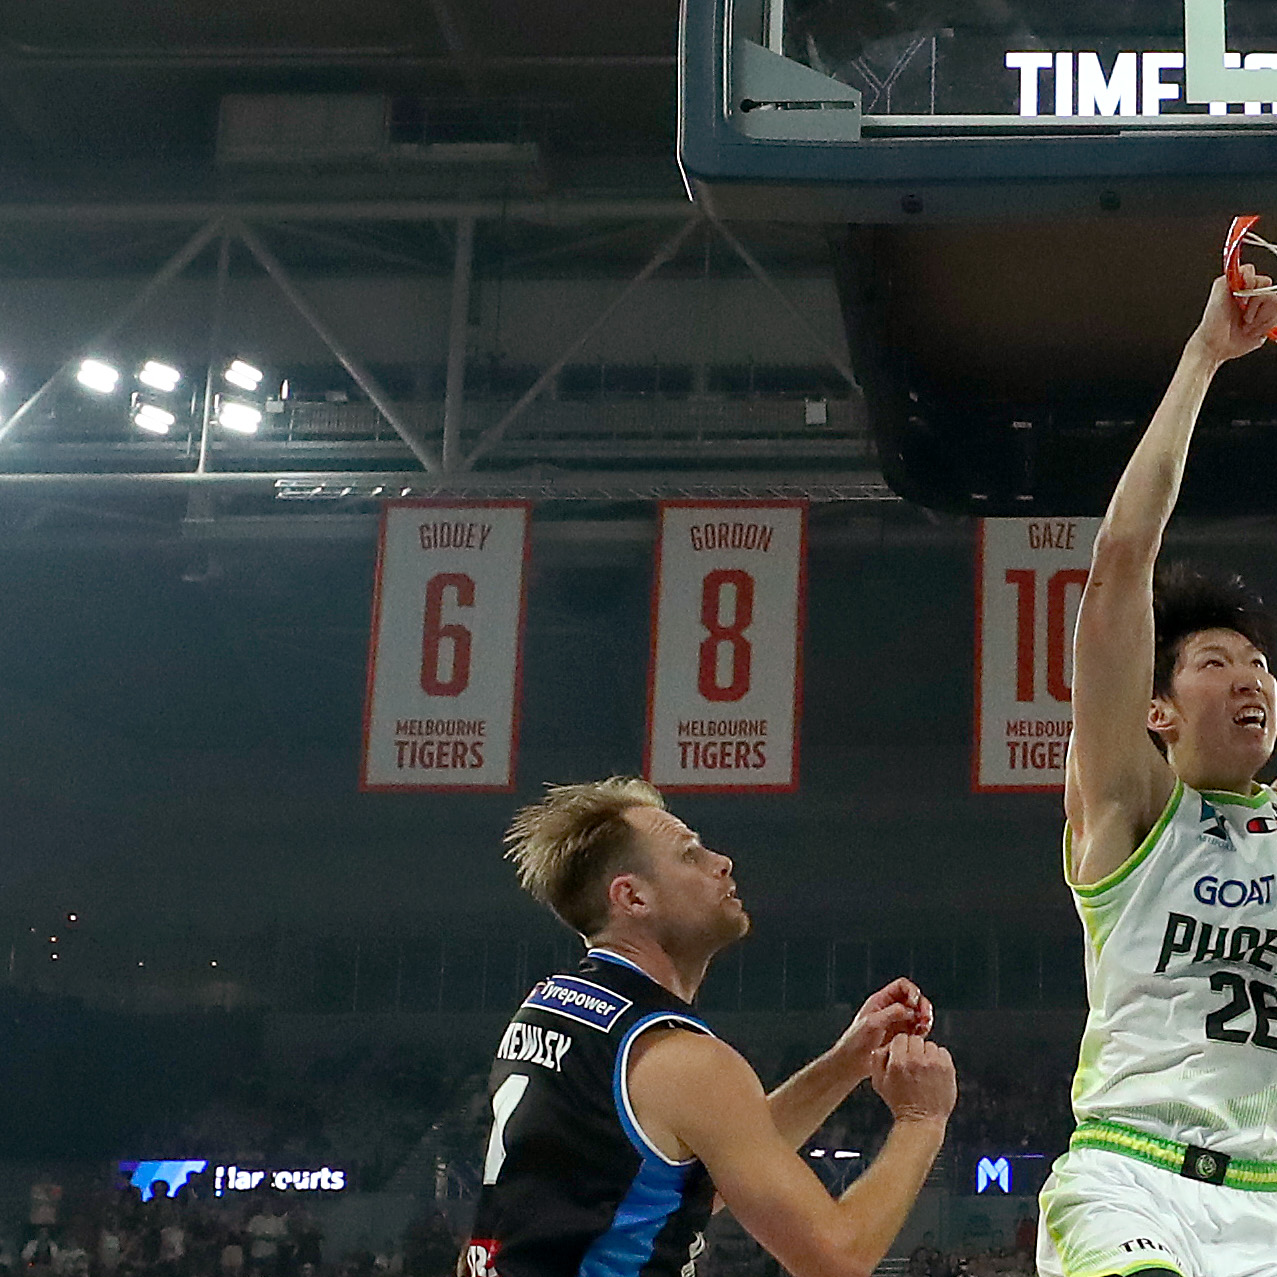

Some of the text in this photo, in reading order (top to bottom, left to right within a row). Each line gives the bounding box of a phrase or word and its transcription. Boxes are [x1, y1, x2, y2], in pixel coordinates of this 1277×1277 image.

[418, 521, 493, 552] GIDDEY
[690, 522, 775, 553] GORDON
[1028, 522, 1077, 551] GAZE
[420, 572, 476, 698] 6
[698, 568, 755, 703] 8
[1005, 569, 1090, 703] 10
[395, 719, 487, 738] MELBOURNE
[677, 720, 768, 738] MELBOURNE
[1006, 720, 1074, 737] MELBOUR
[394, 740, 484, 769] TIGERS
[678, 740, 767, 770] TIGERS
[1007, 741, 1069, 770] TIGE
[1194, 874, 1275, 908] GOAT
[541, 977, 617, 1017] Tyrepower
[214, 1164, 347, 1191] Harourts
